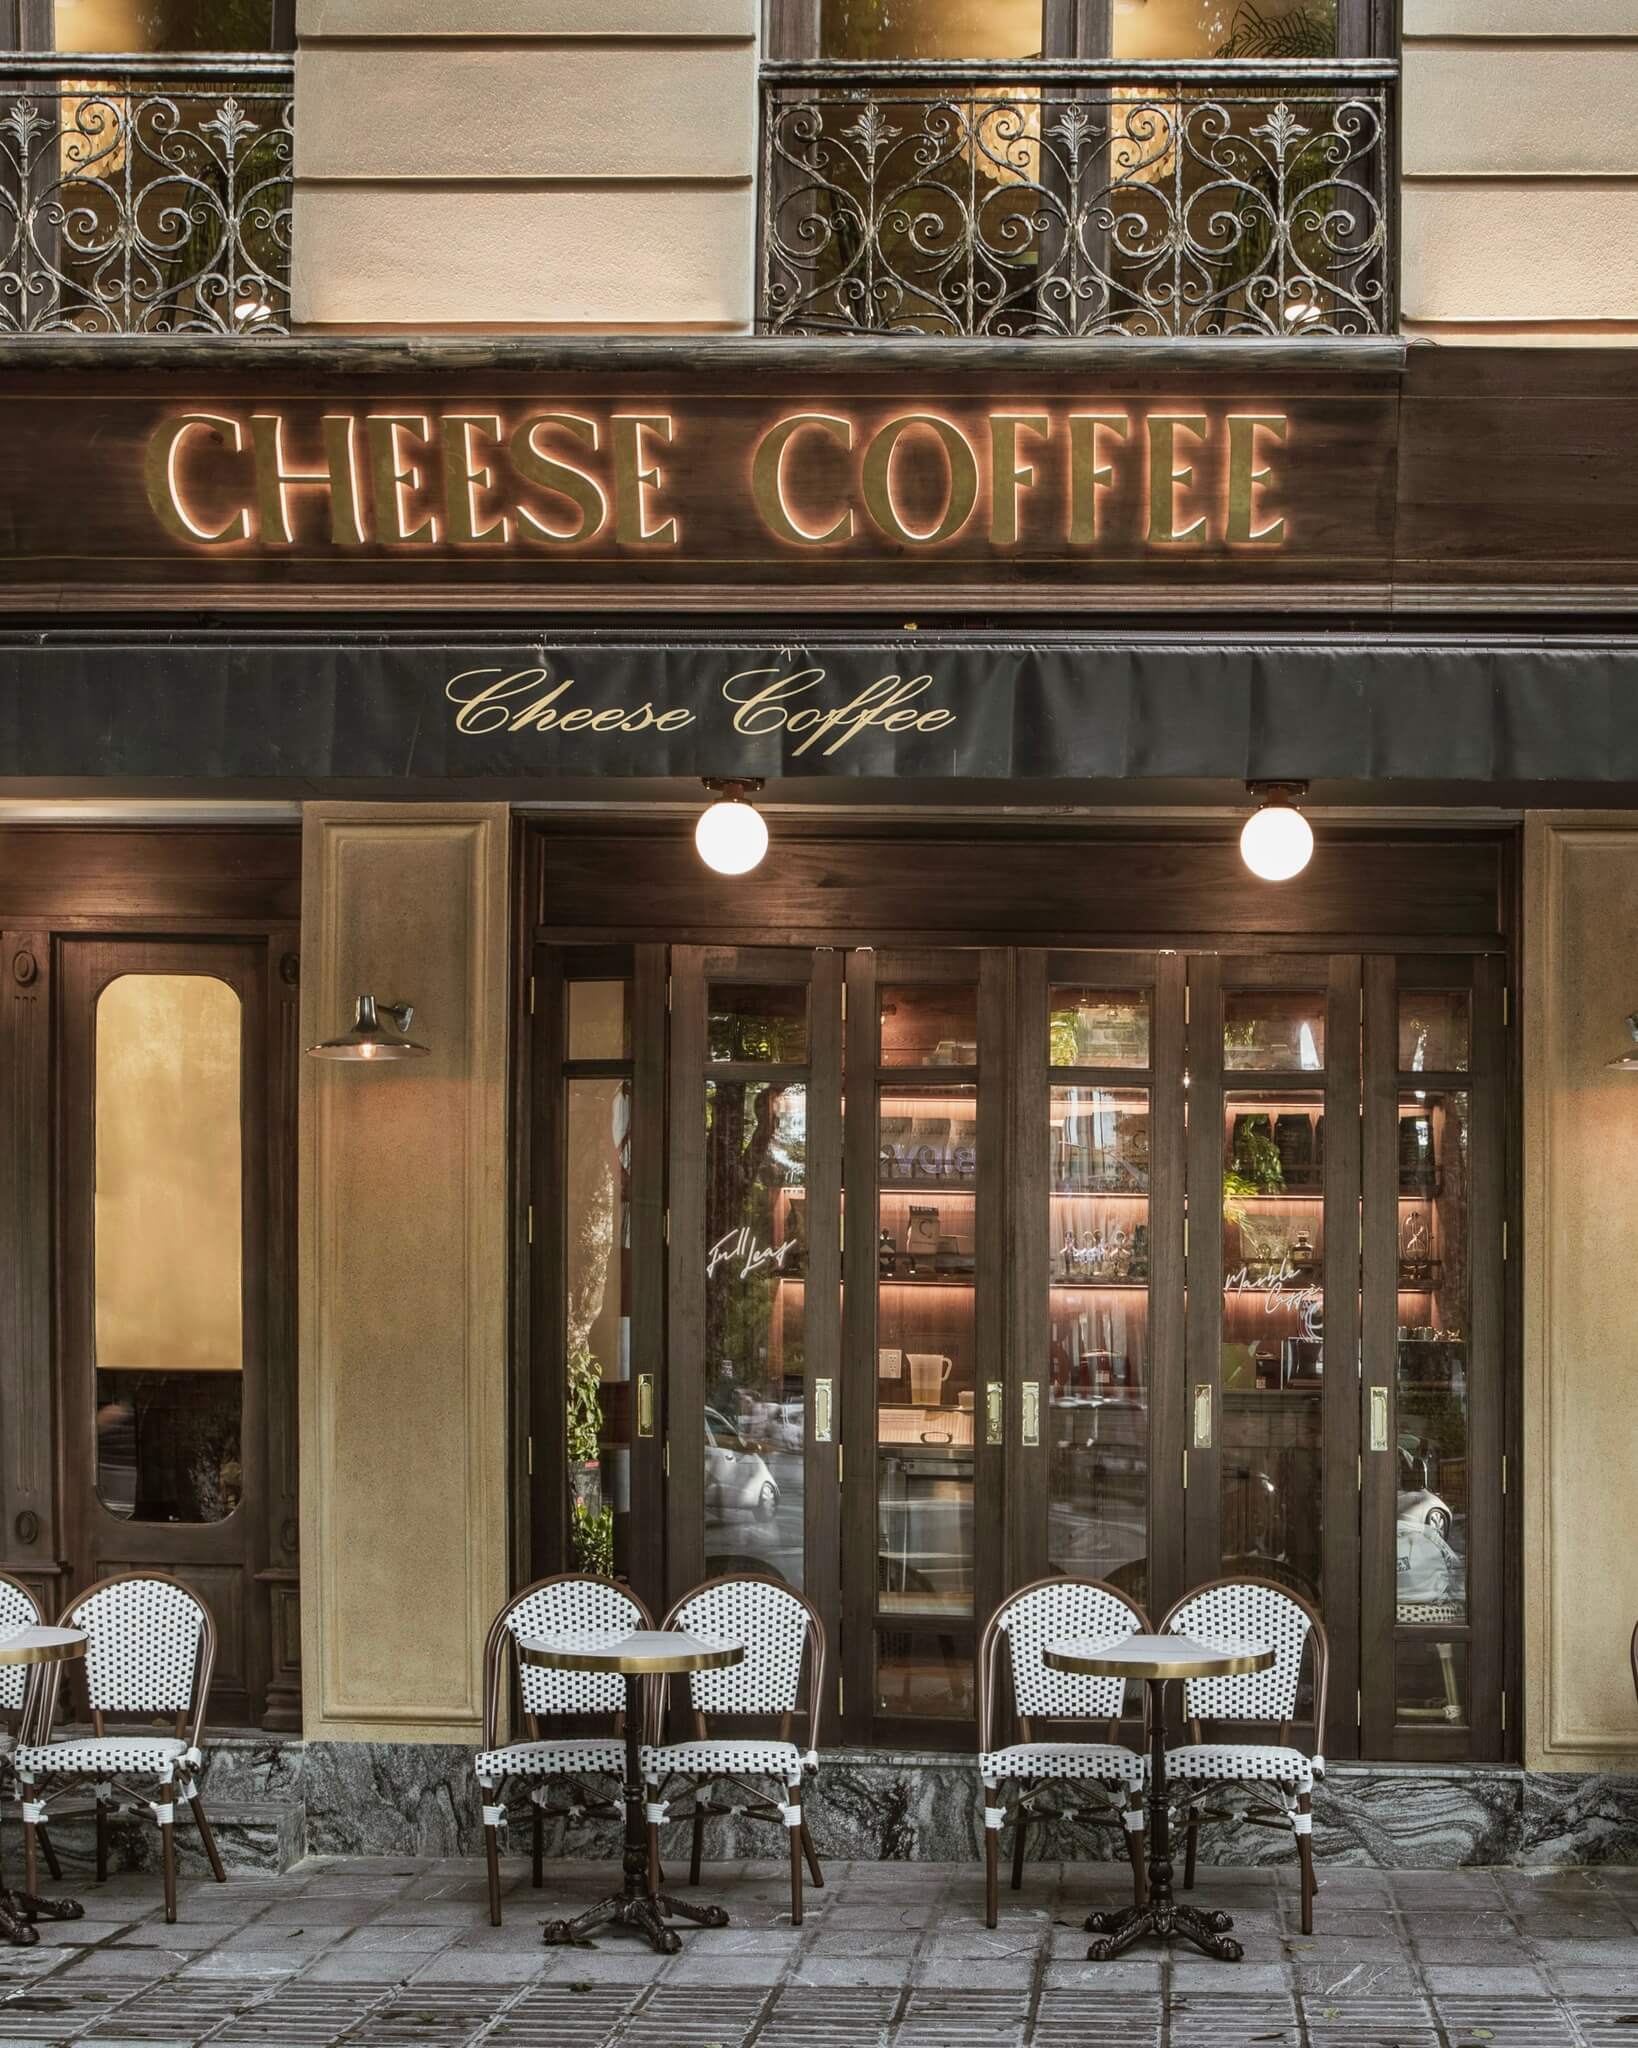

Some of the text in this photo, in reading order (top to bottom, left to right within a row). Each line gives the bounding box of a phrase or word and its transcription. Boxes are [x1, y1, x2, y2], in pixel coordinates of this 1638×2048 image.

[145, 413, 1288, 546] CHEESE COFFEE
[445, 668, 958, 757] Cheese Coffee
